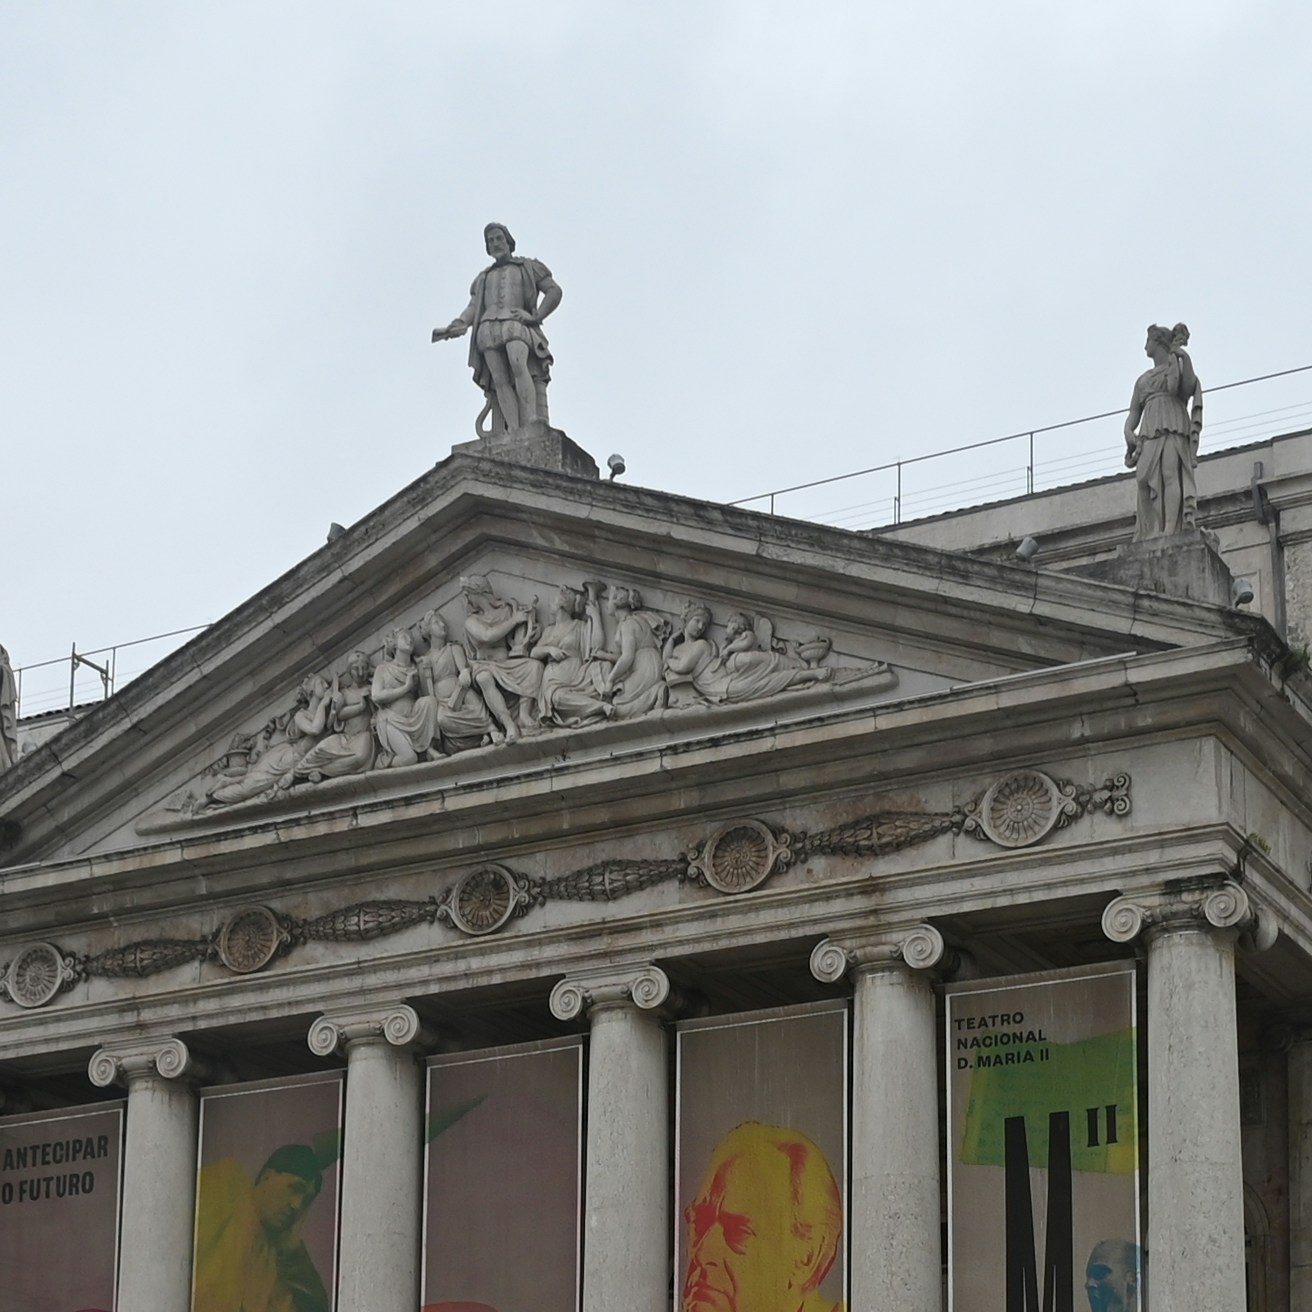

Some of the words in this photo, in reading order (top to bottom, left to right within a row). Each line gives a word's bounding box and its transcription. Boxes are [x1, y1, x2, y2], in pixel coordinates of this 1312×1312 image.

[954, 1011, 1025, 1031] TEATRO
[957, 1029, 1047, 1050] NACIONAL
[957, 1057, 974, 1070] D.
[977, 1049, 1034, 1068] MARIA
[1039, 1048, 1050, 1062] II
[2, 1135, 109, 1171] ANTECIPAR
[1, 1182, 14, 1205] O
[18, 1171, 95, 1202] FUTURO
